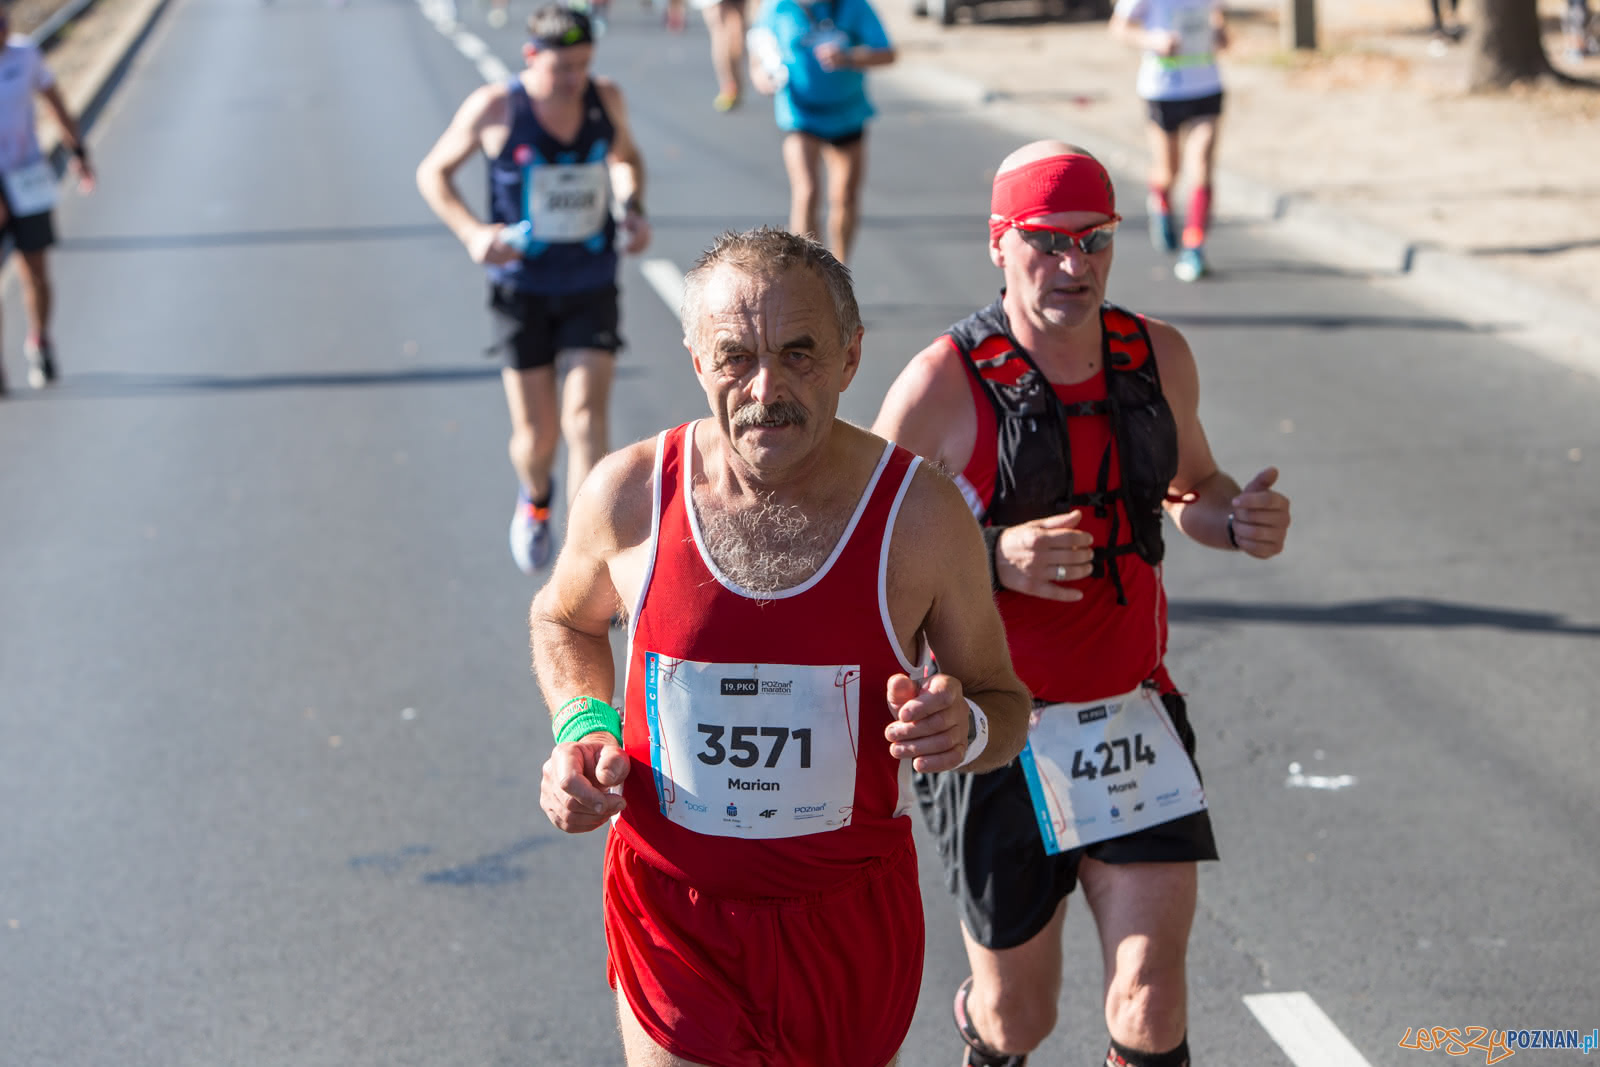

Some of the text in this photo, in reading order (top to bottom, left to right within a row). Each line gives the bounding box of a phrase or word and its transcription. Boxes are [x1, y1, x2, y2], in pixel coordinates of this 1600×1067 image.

[725, 683, 756, 691] 19. PKO
[697, 723, 811, 768] 3571
[1071, 733, 1156, 780] 4274
[728, 778, 780, 791] Marian
[1107, 780, 1137, 795] Marek
[759, 809, 778, 819] 4F
